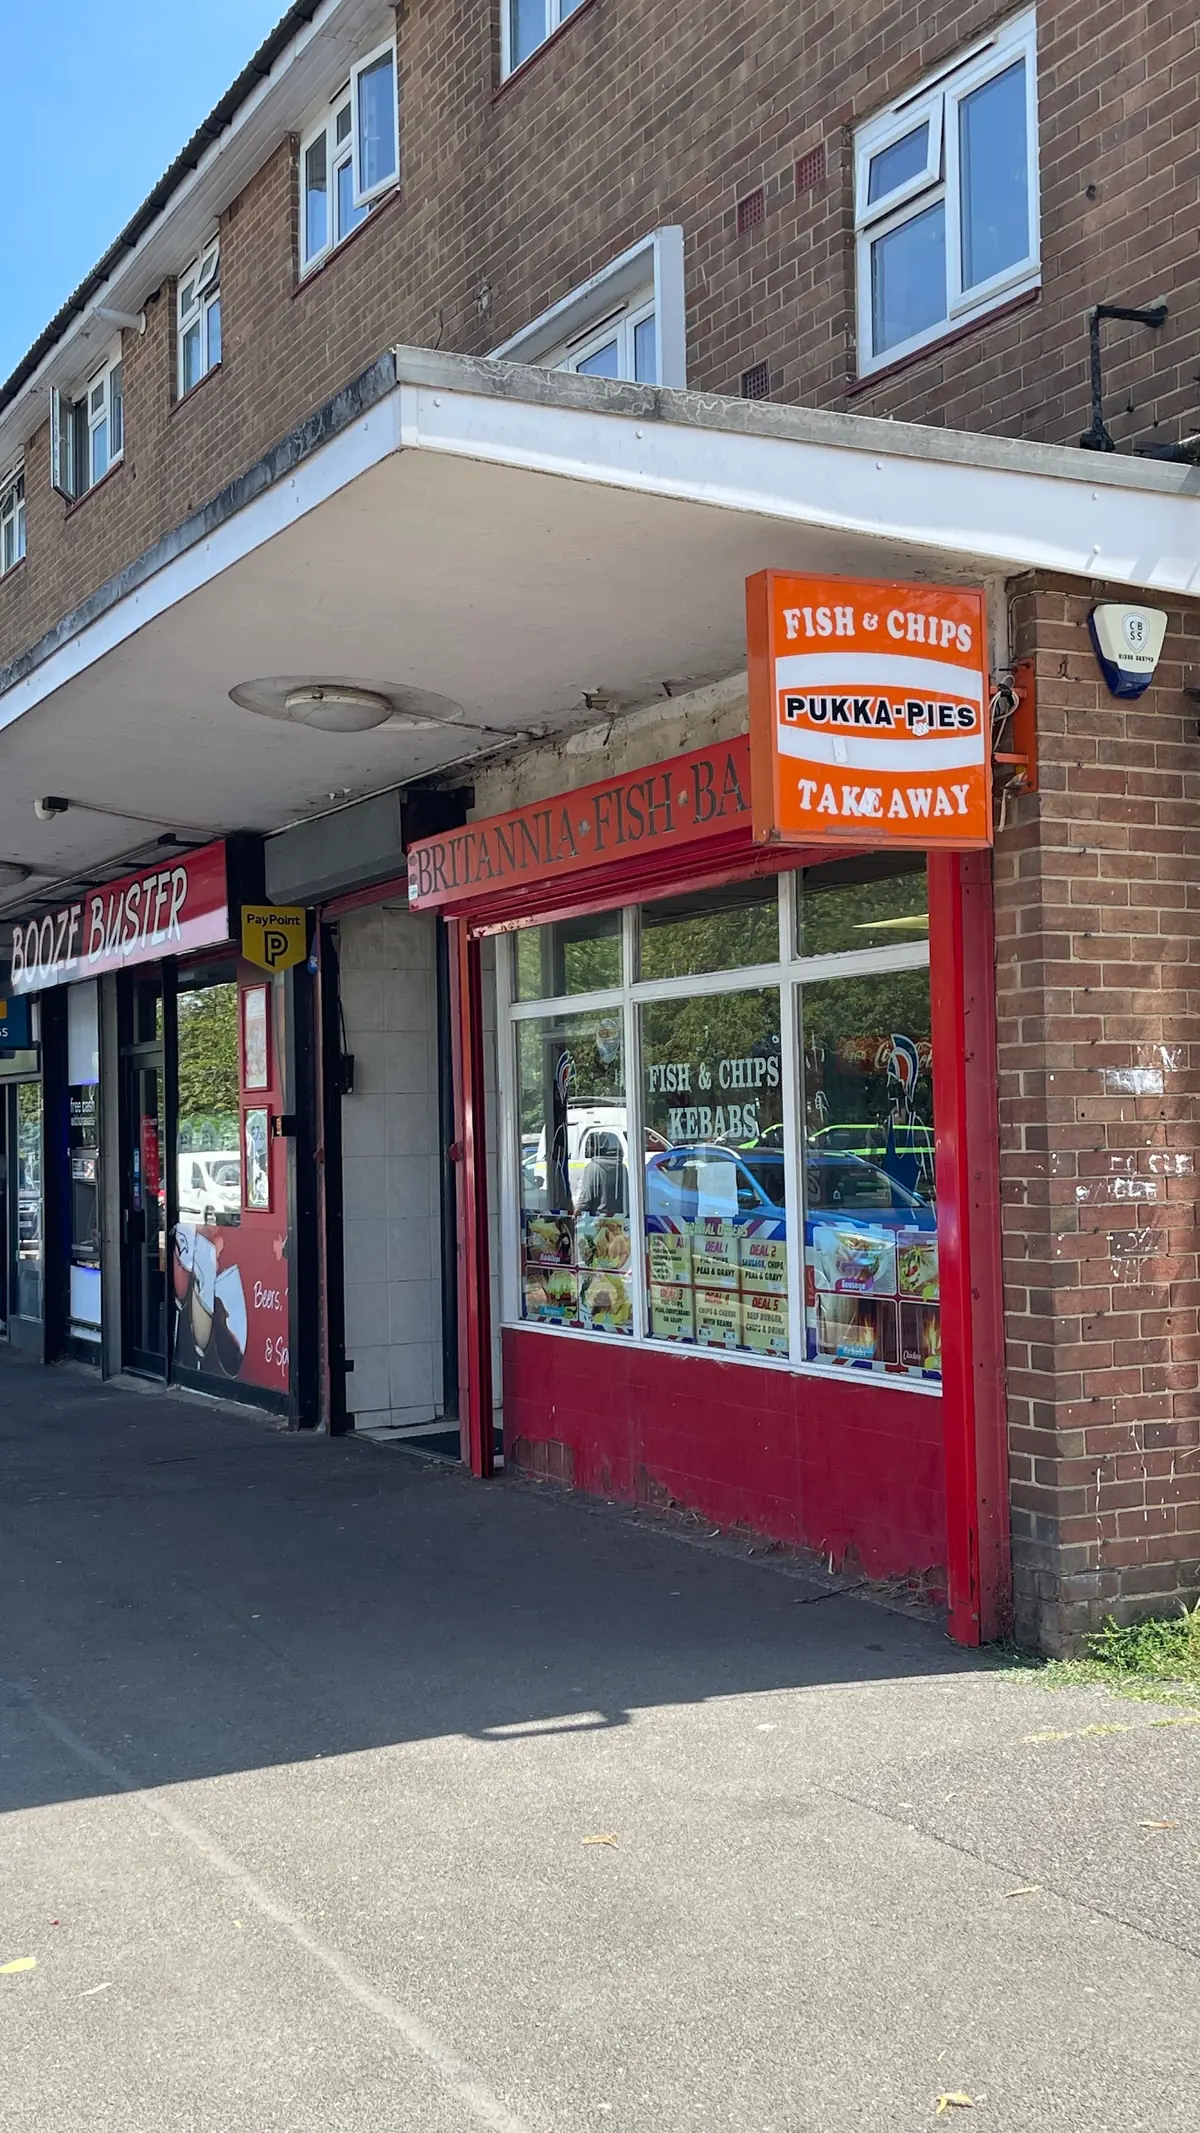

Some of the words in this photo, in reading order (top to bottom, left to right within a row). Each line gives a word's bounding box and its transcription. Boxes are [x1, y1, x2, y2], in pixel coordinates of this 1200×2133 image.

[783, 606, 855, 640] FISH
[862, 612, 879, 631] &
[886, 609, 973, 653] CHIPS
[797, 778, 970, 820] TAKEAWAY
[416, 806, 580, 897] BRITANNIA
[591, 771, 677, 852] FISH
[690, 752, 750, 824] BA
[11, 903, 82, 986] BOOZE
[88, 866, 189, 964] BUSTER
[246, 913, 301, 927] PayPoint
[649, 1063, 692, 1093] FISH
[698, 1061, 712, 1091] &
[719, 1055, 780, 1090] CHIPS
[668, 1103, 757, 1140] KEBABS
[749, 1244, 769, 1256] DEAL
[771, 1245, 777, 1257] 2
[751, 1296, 771, 1310] DEAL
[773, 1299, 779, 1311] 5
